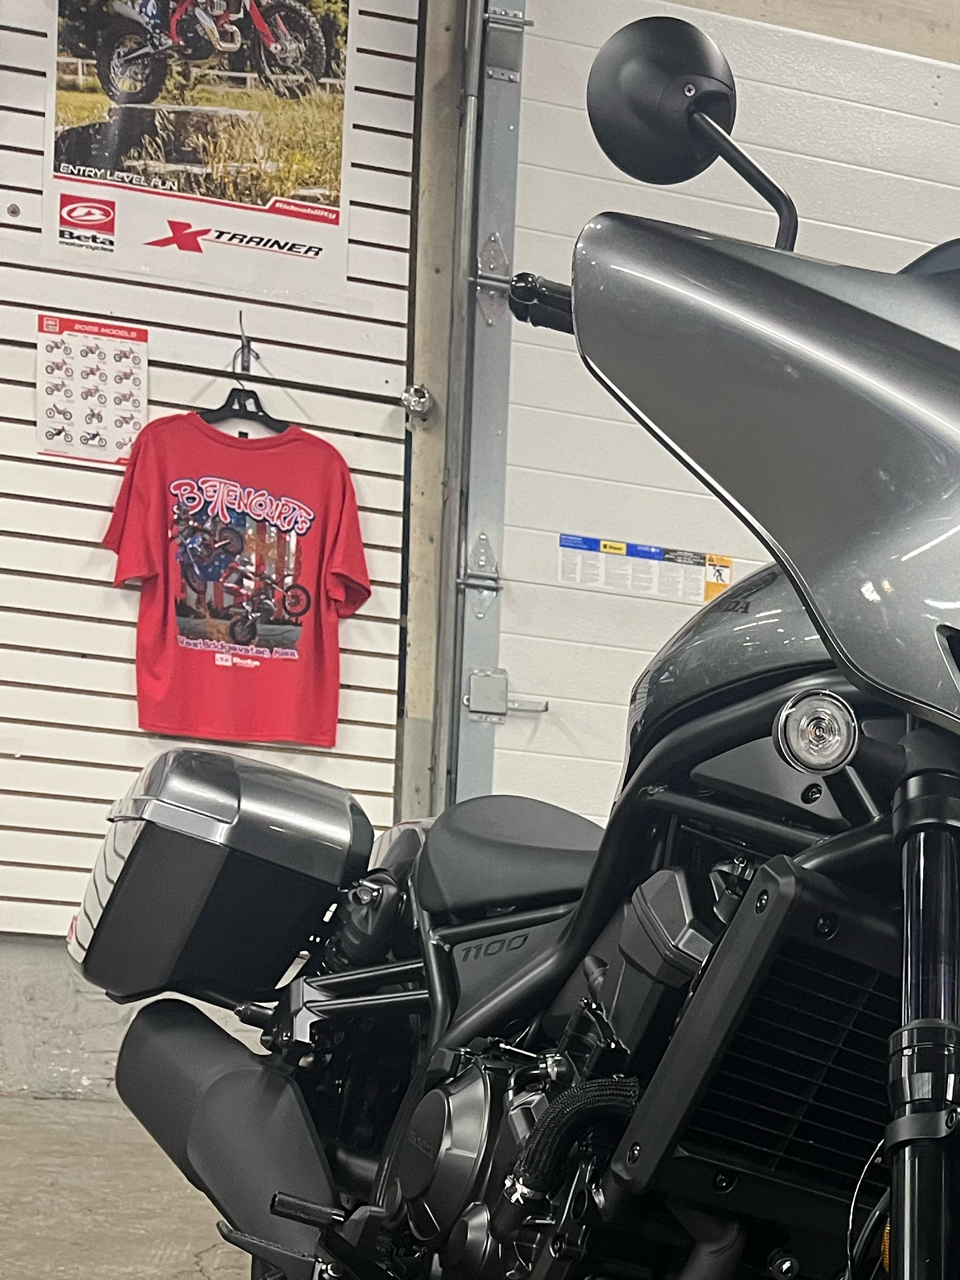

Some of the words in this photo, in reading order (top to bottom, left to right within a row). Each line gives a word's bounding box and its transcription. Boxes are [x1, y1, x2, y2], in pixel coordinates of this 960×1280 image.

[60, 163, 105, 178] ENTRY
[107, 170, 148, 186] LEVEL
[151, 178, 178, 190] FUN
[59, 229, 114, 246] Beta
[100, 327, 138, 338] MODELS
[462, 933, 529, 962] 1100
